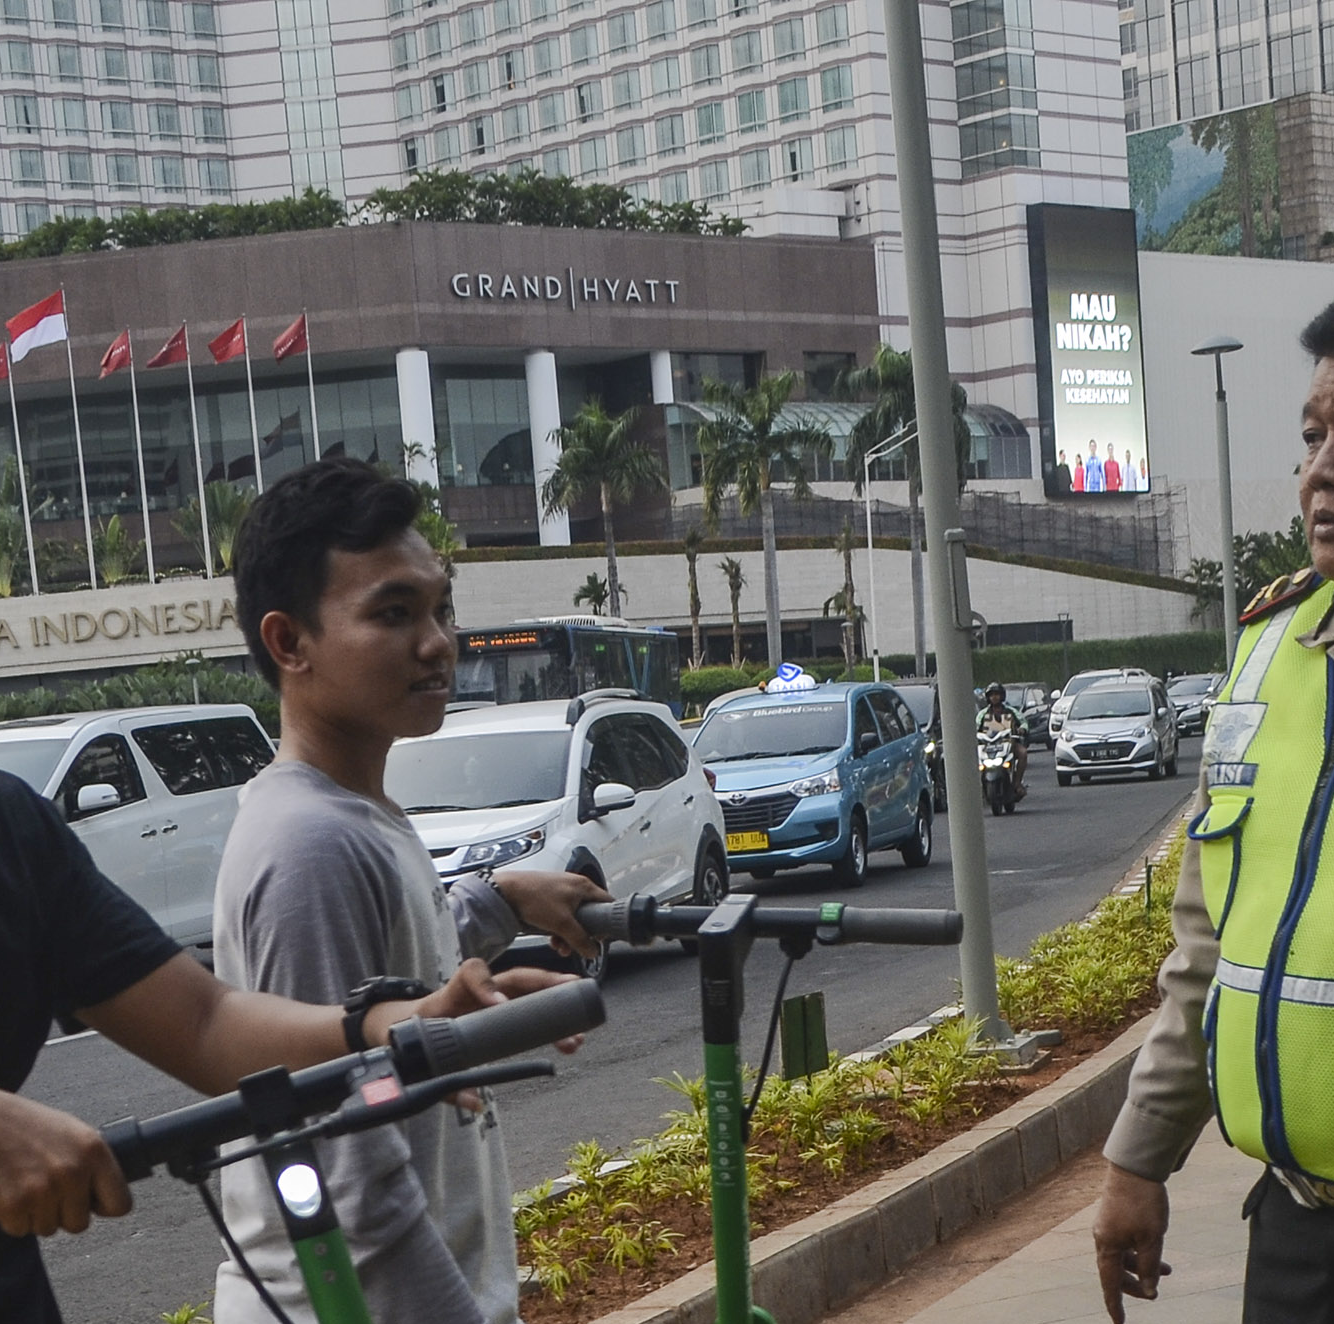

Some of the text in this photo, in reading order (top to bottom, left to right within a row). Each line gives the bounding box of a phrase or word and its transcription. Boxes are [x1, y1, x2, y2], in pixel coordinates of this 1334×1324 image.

[452, 273, 679, 303] GRAND HYATT
[1070, 293, 1116, 321] MAU
[1056, 323, 1132, 351] NIKAH?
[1060, 369, 1133, 386] AYO PERIKSA
[1065, 388, 1130, 404] KESEHATAN
[29, 597, 242, 648] INDONESIA
[752, 705, 833, 717] Bluebird Group
[1207, 764, 1246, 784] LISI
